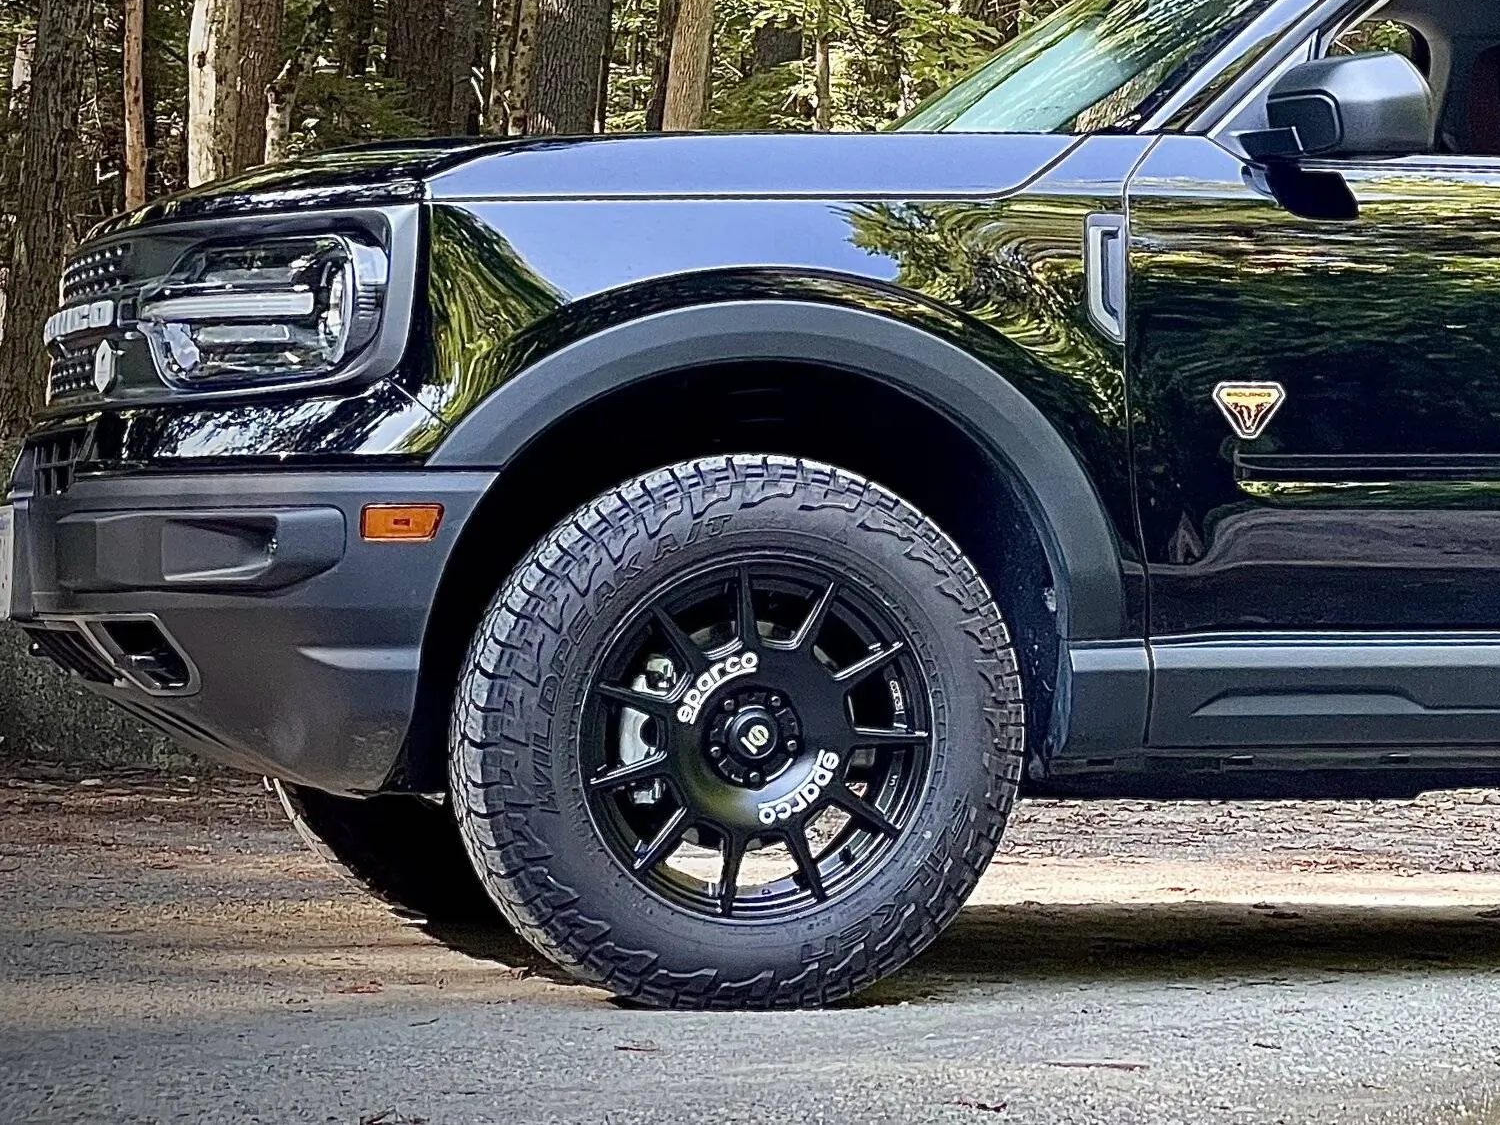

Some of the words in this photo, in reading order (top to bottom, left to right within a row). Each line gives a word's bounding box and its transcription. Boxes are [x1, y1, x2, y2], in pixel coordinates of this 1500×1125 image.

[530, 549, 643, 814] WILDPEAK
[677, 650, 759, 726] sparco
[758, 749, 839, 825] sparco
